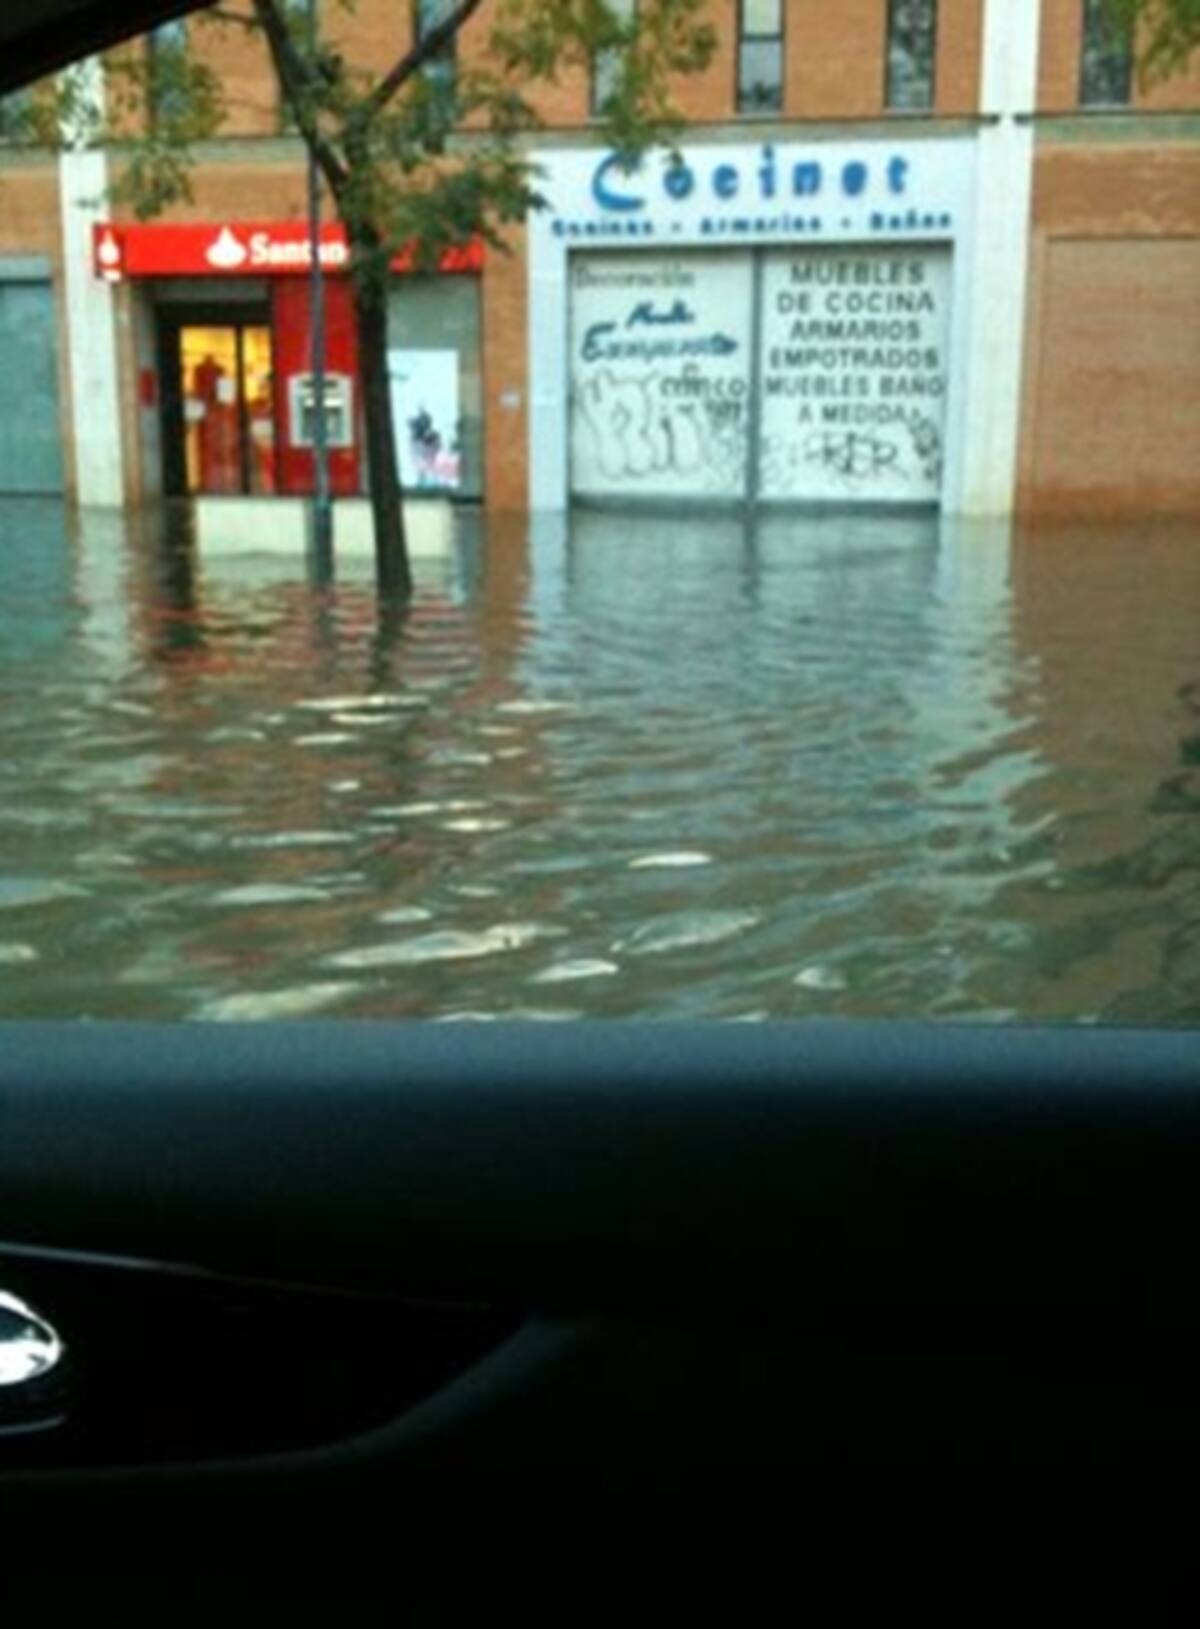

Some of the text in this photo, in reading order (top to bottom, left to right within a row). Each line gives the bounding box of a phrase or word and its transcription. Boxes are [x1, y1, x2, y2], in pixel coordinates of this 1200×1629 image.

[791, 261, 924, 285] MUEBLES
[777, 290, 934, 314] DE COCINA
[790, 320, 920, 341] ARMARIOS
[769, 348, 938, 370] EMPOTRADOS
[766, 375, 869, 396] MUEBLES
[799, 403, 905, 425] A MEDIDA
